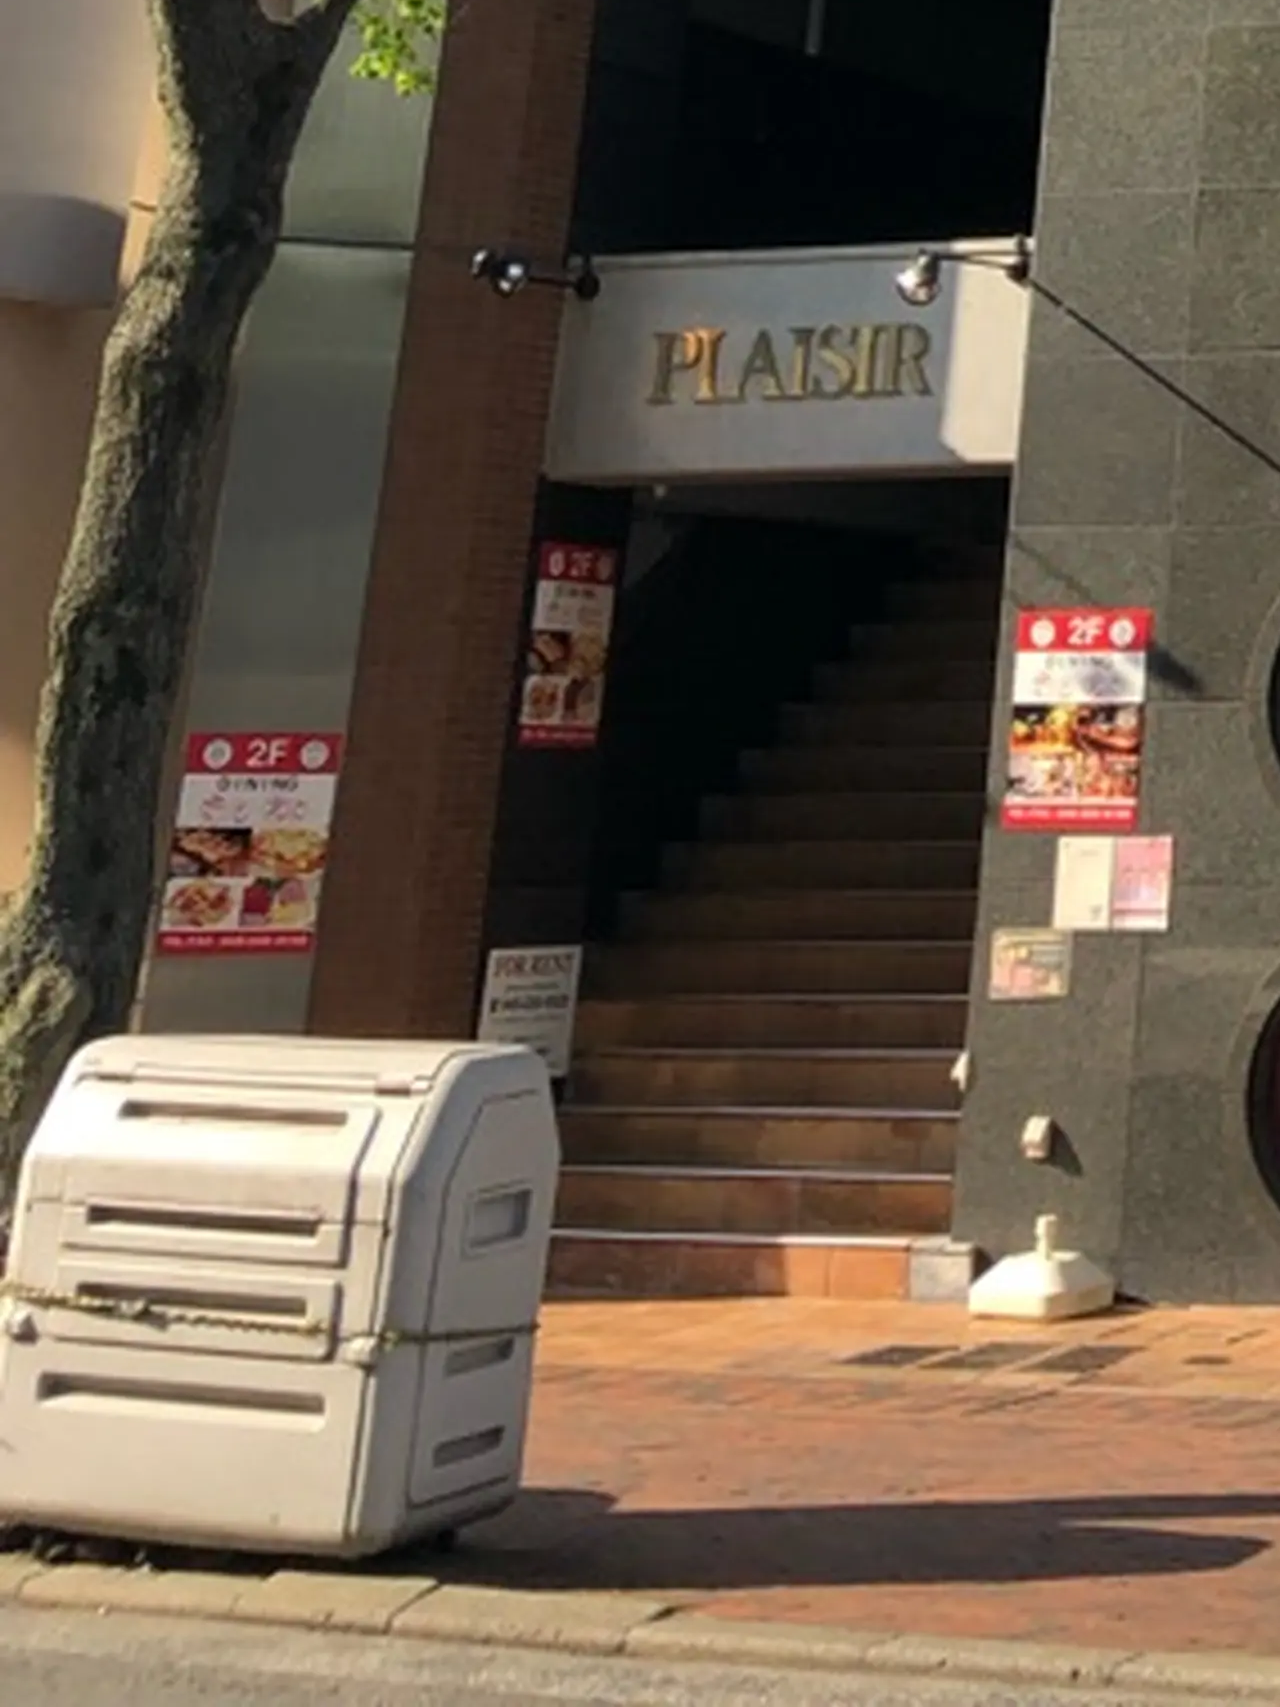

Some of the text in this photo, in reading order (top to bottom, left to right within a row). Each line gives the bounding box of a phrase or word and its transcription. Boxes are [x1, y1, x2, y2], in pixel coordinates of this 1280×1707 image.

[646, 324, 934, 405] PLAISIR
[1067, 616, 1105, 645] 2F
[245, 738, 292, 768] 2F
[216, 777, 299, 792] DINING
[494, 951, 575, 978] FOR RENT
